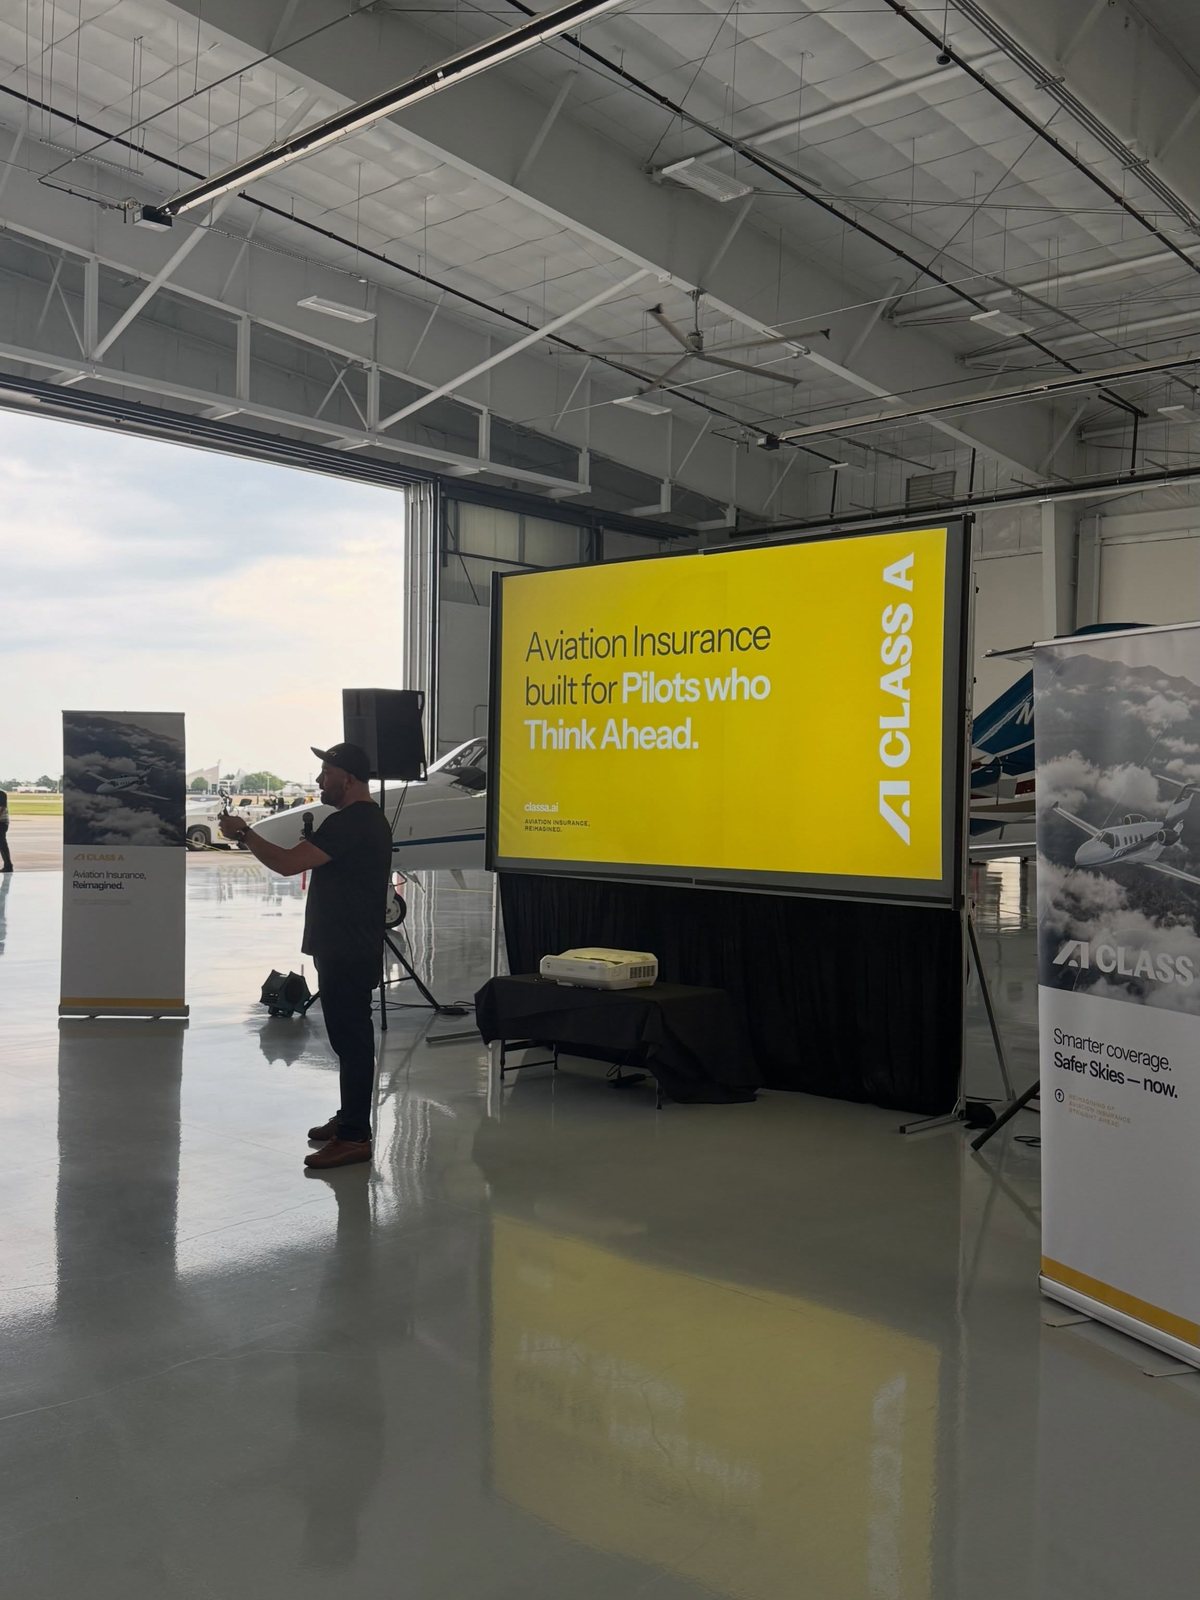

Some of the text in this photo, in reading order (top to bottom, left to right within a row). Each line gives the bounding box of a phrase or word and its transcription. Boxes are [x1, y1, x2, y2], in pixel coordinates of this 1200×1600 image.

[882, 552, 915, 592] A
[525, 625, 771, 662] Aviation Insurance
[525, 667, 771, 706] built for Pilots who
[879, 602, 914, 768] CLASS
[523, 717, 699, 750] Think Ahead.
[524, 802, 559, 813] classa.ai
[73, 870, 147, 880] Aviation Insurance,
[73, 880, 125, 891] Reimagined.
[1096, 944, 1194, 987] CLASS
[1053, 1028, 1172, 1073] Smarter coverage.
[1054, 1052, 1088, 1074] Safer
[1089, 1060, 1125, 1084] Skies
[1143, 1076, 1178, 1099] now.
